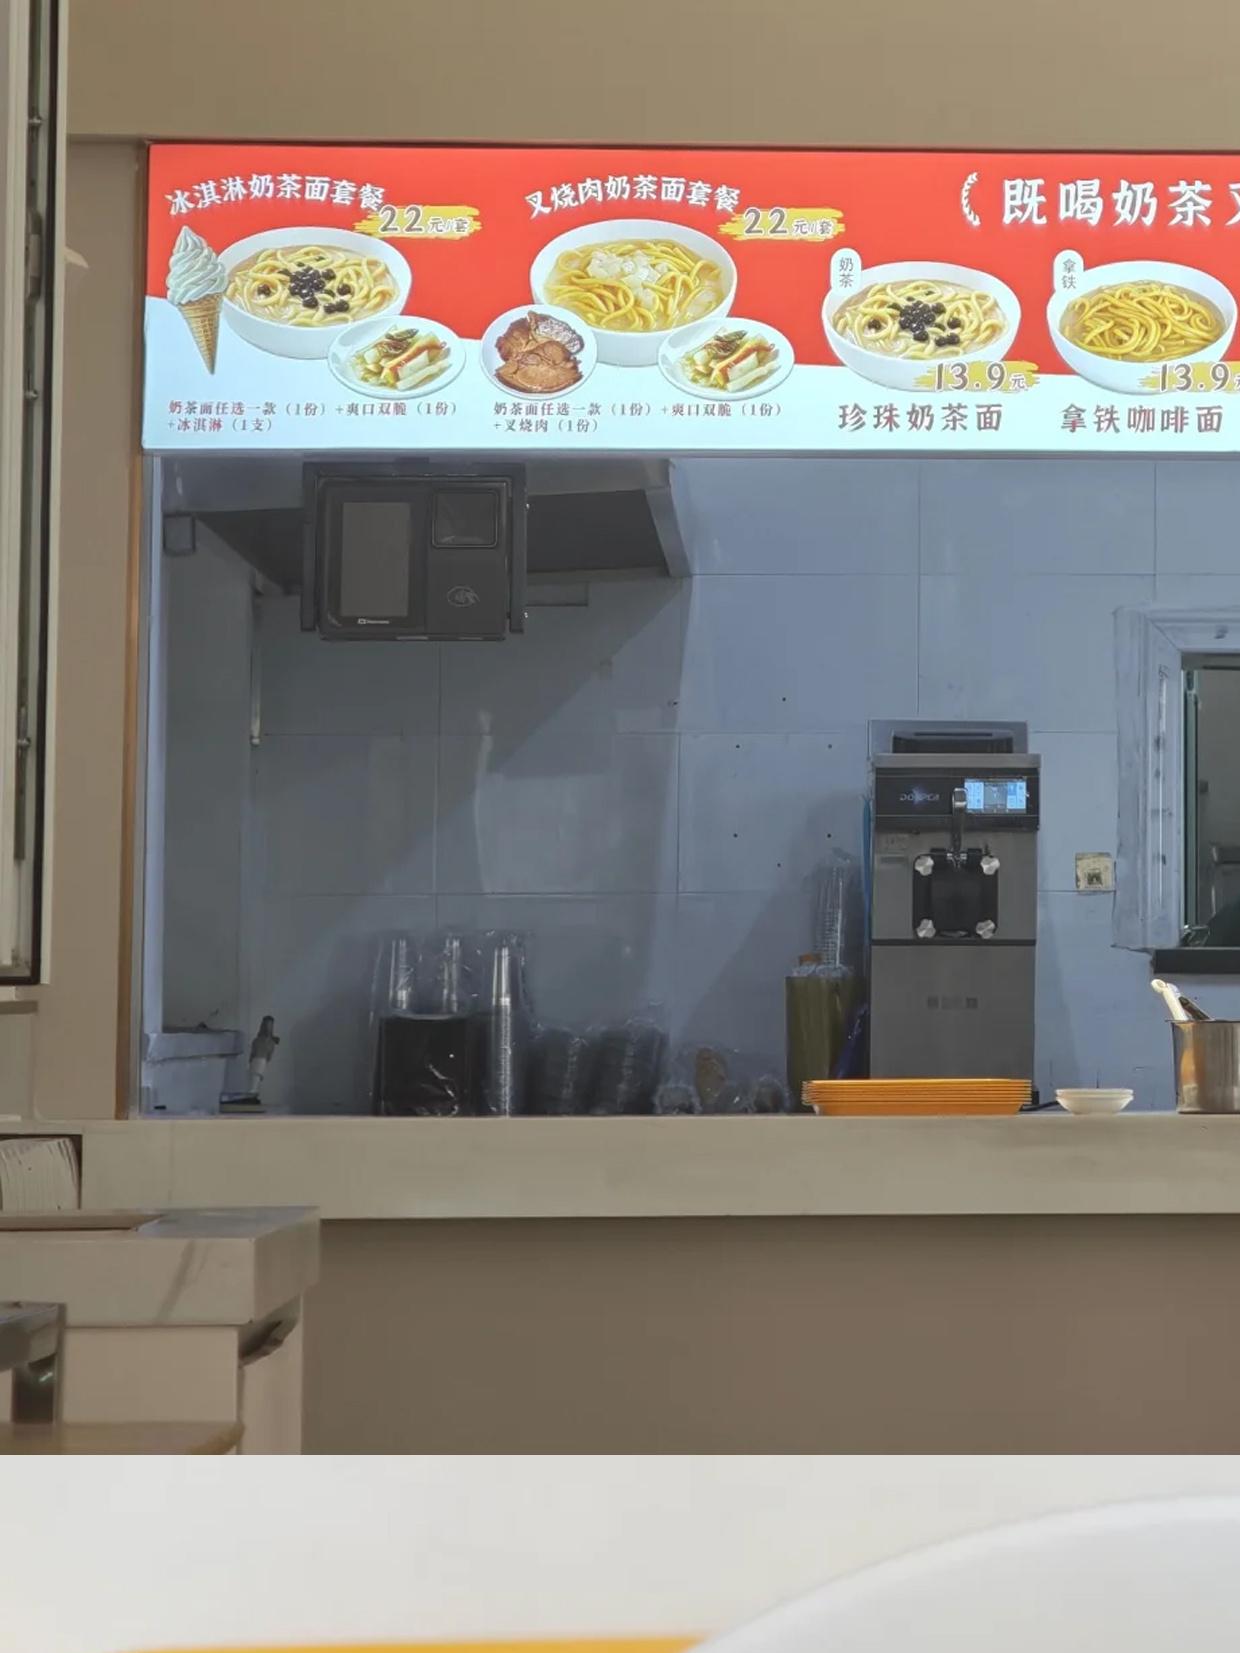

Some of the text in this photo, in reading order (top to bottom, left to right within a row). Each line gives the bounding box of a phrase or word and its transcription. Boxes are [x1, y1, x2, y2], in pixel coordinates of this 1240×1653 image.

[166, 173, 386, 215] 冰淇淋奶茶面套餐
[526, 175, 740, 217] 叉烧肉奶茶面套餐
[838, 257, 855, 289] 奶茶
[1061, 258, 1078, 290] 拿铁
[838, 404, 1003, 433] 珍珠奶茶面
[1060, 404, 1224, 434] 拿铁咖啡面
